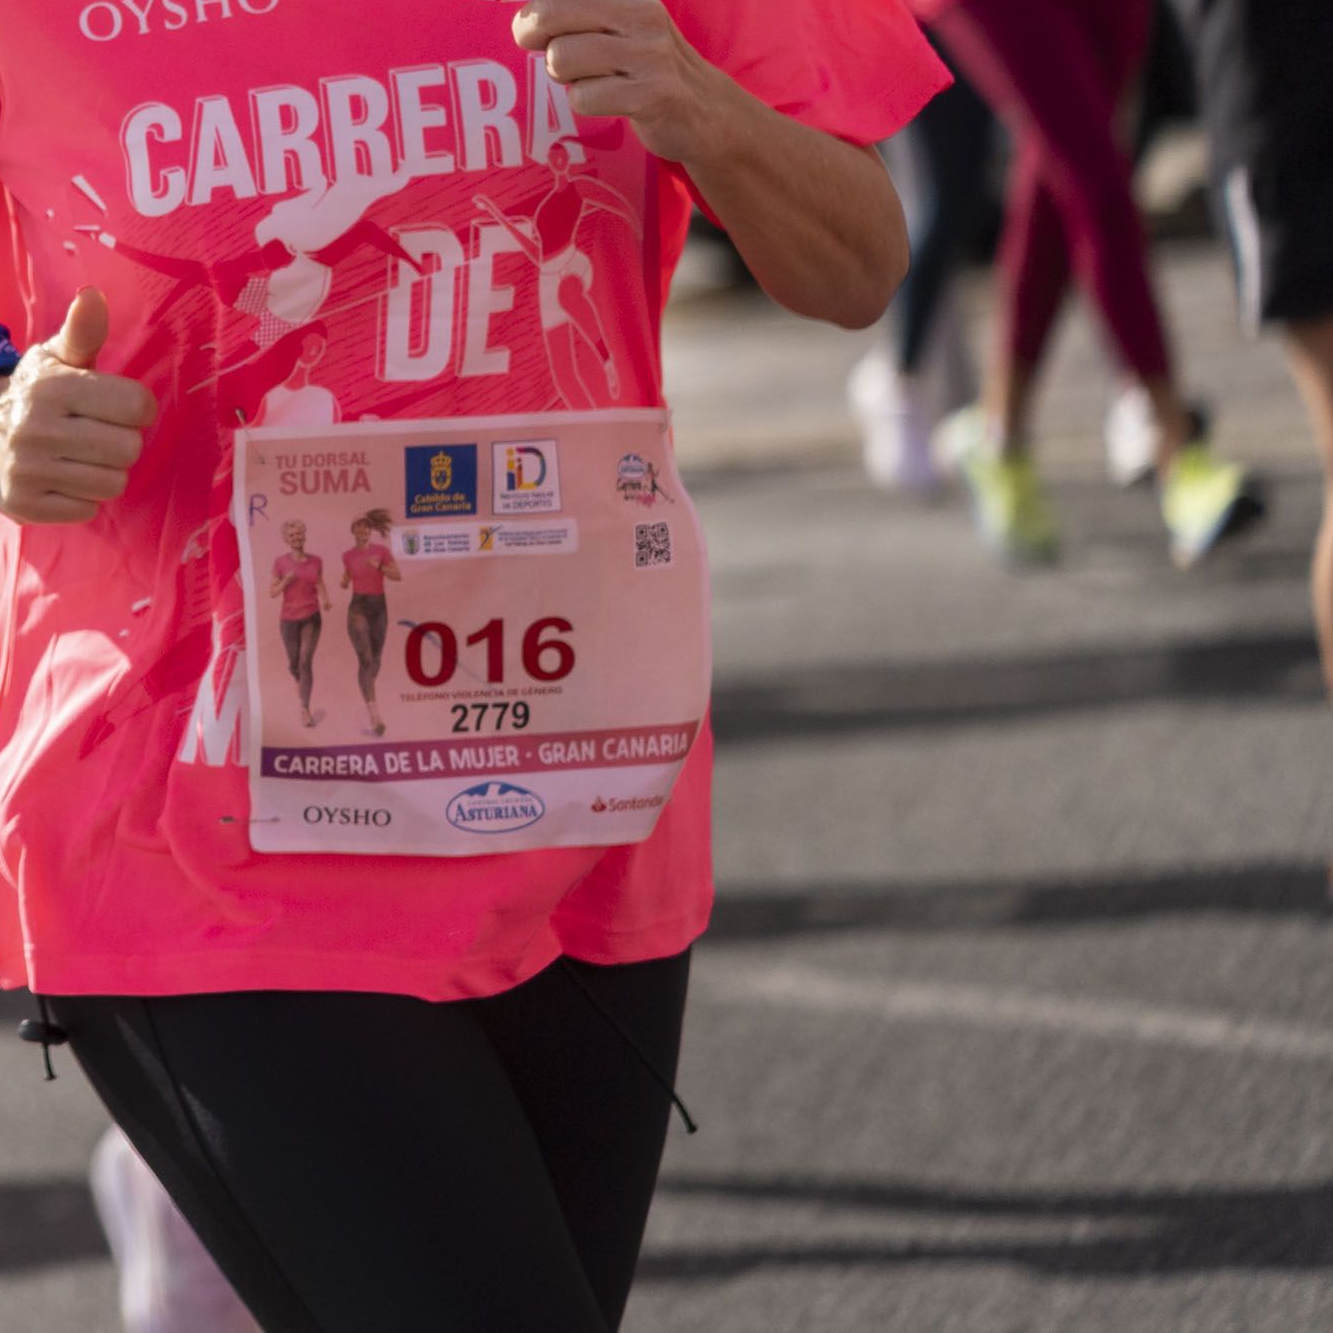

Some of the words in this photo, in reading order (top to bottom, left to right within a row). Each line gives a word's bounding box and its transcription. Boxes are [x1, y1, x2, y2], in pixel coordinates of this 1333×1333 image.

[121, 54, 587, 218] CARRERA
[375, 217, 537, 382] DE
[275, 454, 297, 469] TU
[302, 451, 371, 468] DORSAL
[279, 467, 372, 495] SUMA
[405, 617, 575, 687] 016
[451, 689, 504, 700] VIOLENCIA
[451, 701, 530, 733] 2779
[274, 754, 379, 776] CARRERA
[384, 751, 412, 774] DE
[417, 749, 443, 772] LA
[449, 745, 520, 769] MUJER
[538, 739, 596, 765] GRAN
[603, 733, 688, 760] CANARIA
[303, 805, 392, 827] OYSHO
[453, 802, 537, 823] ASTURIANA
